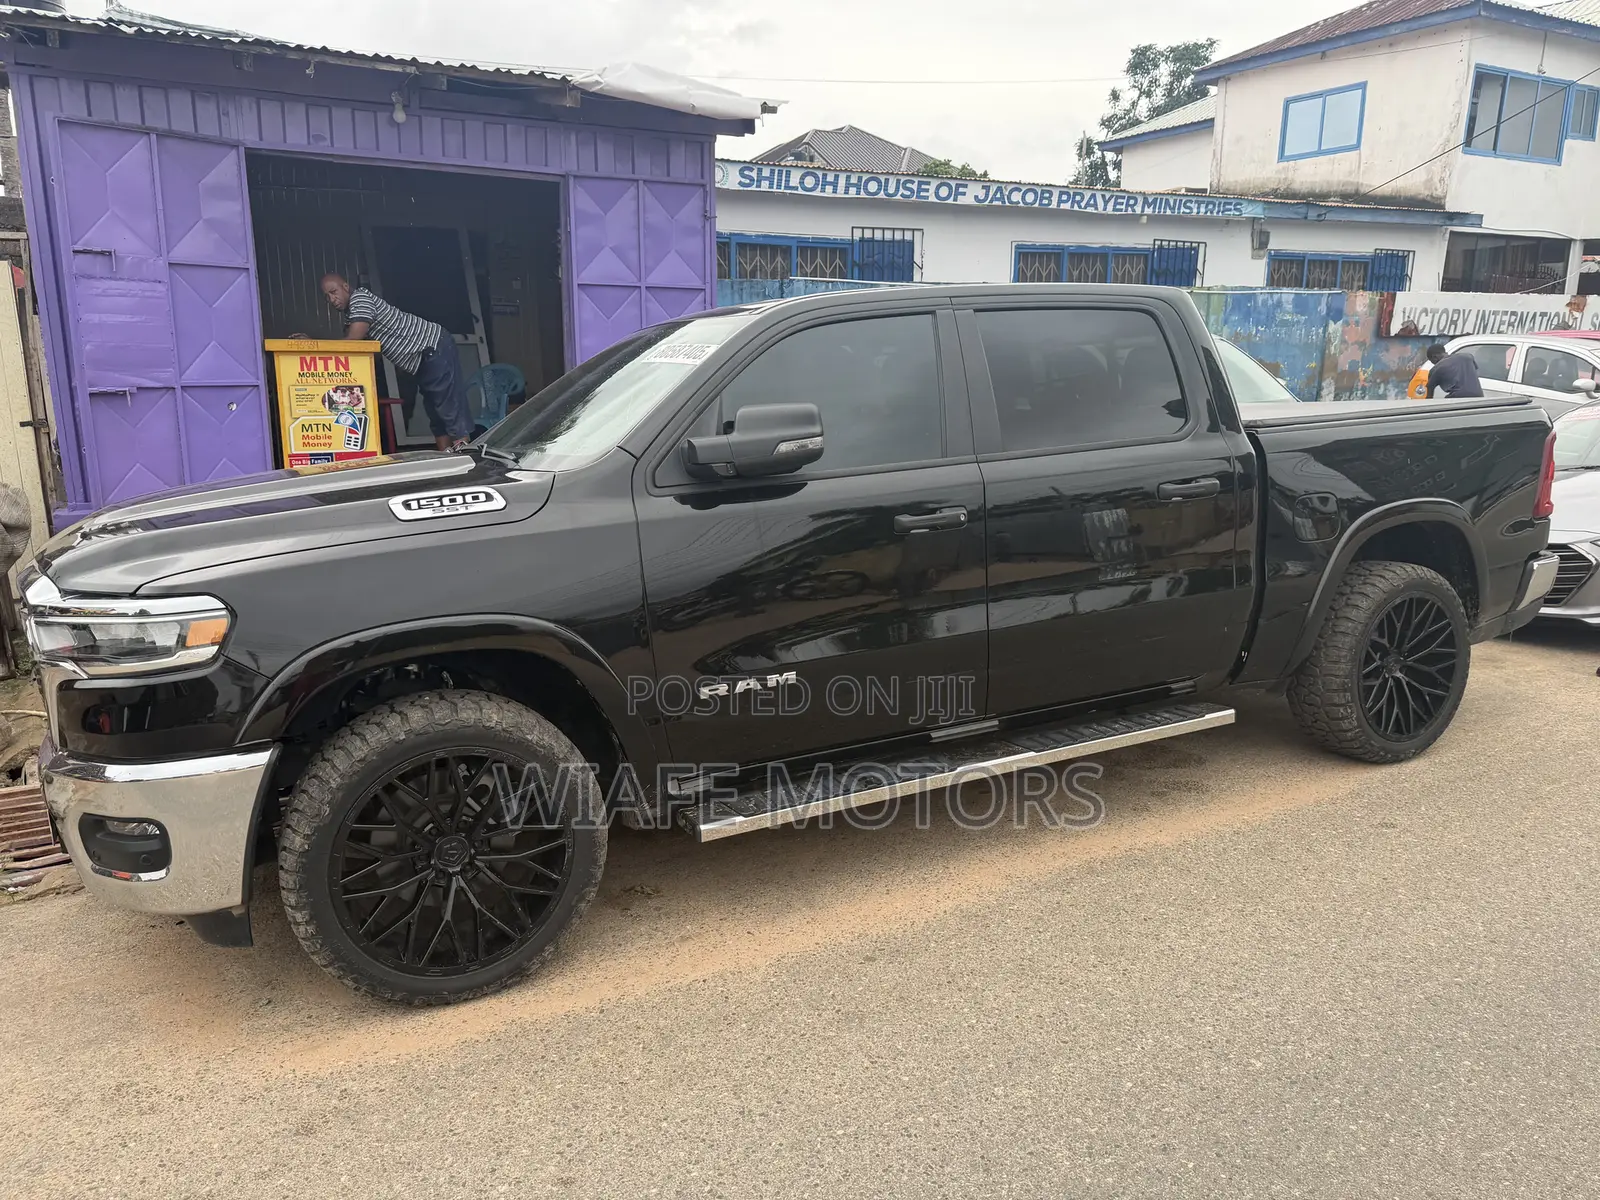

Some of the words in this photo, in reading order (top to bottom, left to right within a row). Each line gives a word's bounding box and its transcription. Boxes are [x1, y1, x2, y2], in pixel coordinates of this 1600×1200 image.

[737, 165, 840, 194] SHILOH
[844, 175, 931, 200] HOUSE
[934, 181, 967, 202] OF
[973, 184, 1053, 208] JACOB
[1057, 190, 1138, 213] PRAYER
[1141, 196, 1243, 216] MINISTRIES
[299, 356, 350, 371] MTN
[301, 423, 332, 432] MTN
[406, 492, 487, 509] 1500
[699, 671, 797, 699] RAM
